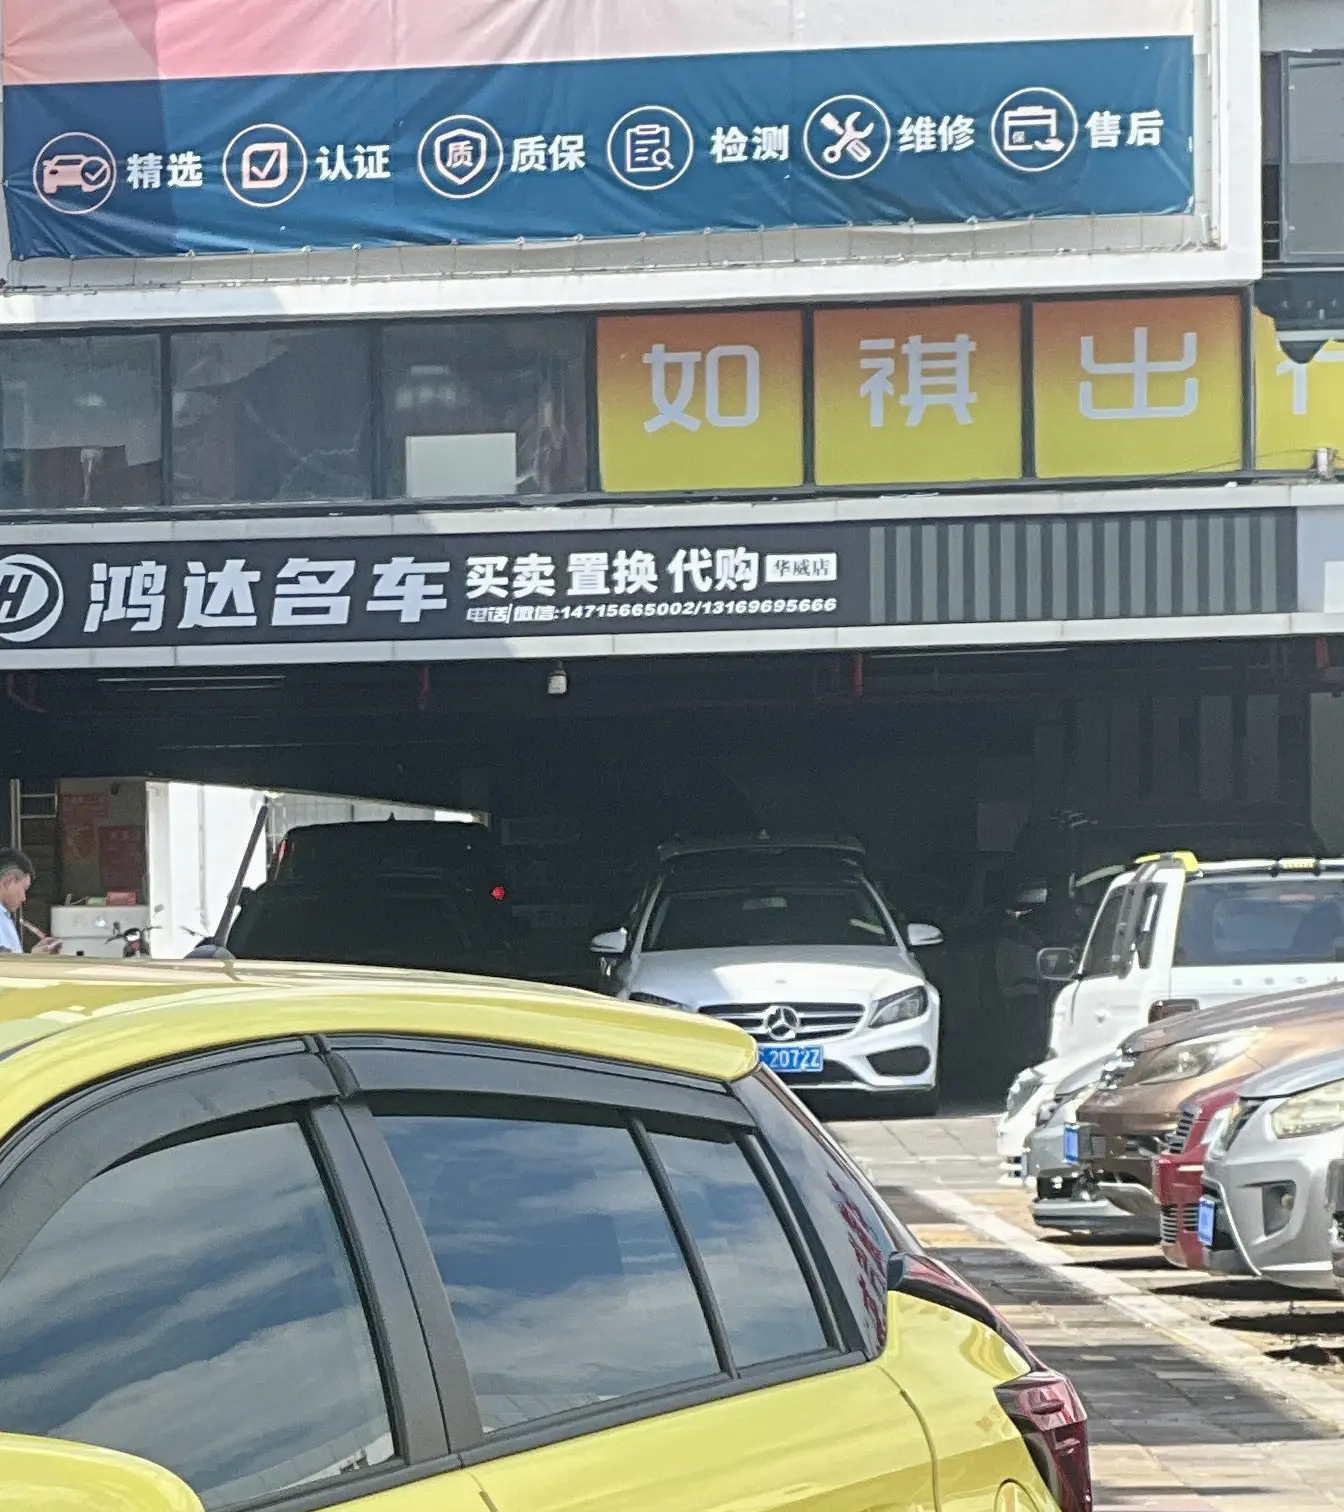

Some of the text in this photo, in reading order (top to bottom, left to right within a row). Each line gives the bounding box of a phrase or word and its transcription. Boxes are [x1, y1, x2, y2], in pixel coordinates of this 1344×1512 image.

[125, 151, 204, 191] 精选
[315, 144, 391, 183] 认证
[510, 134, 586, 174] 质保
[710, 124, 790, 163] 检测
[898, 115, 976, 154] 维修
[1085, 109, 1165, 150] 售后
[83, 555, 451, 633] 鸿达名车
[465, 546, 832, 599] 买卖 置换 代购 华威店
